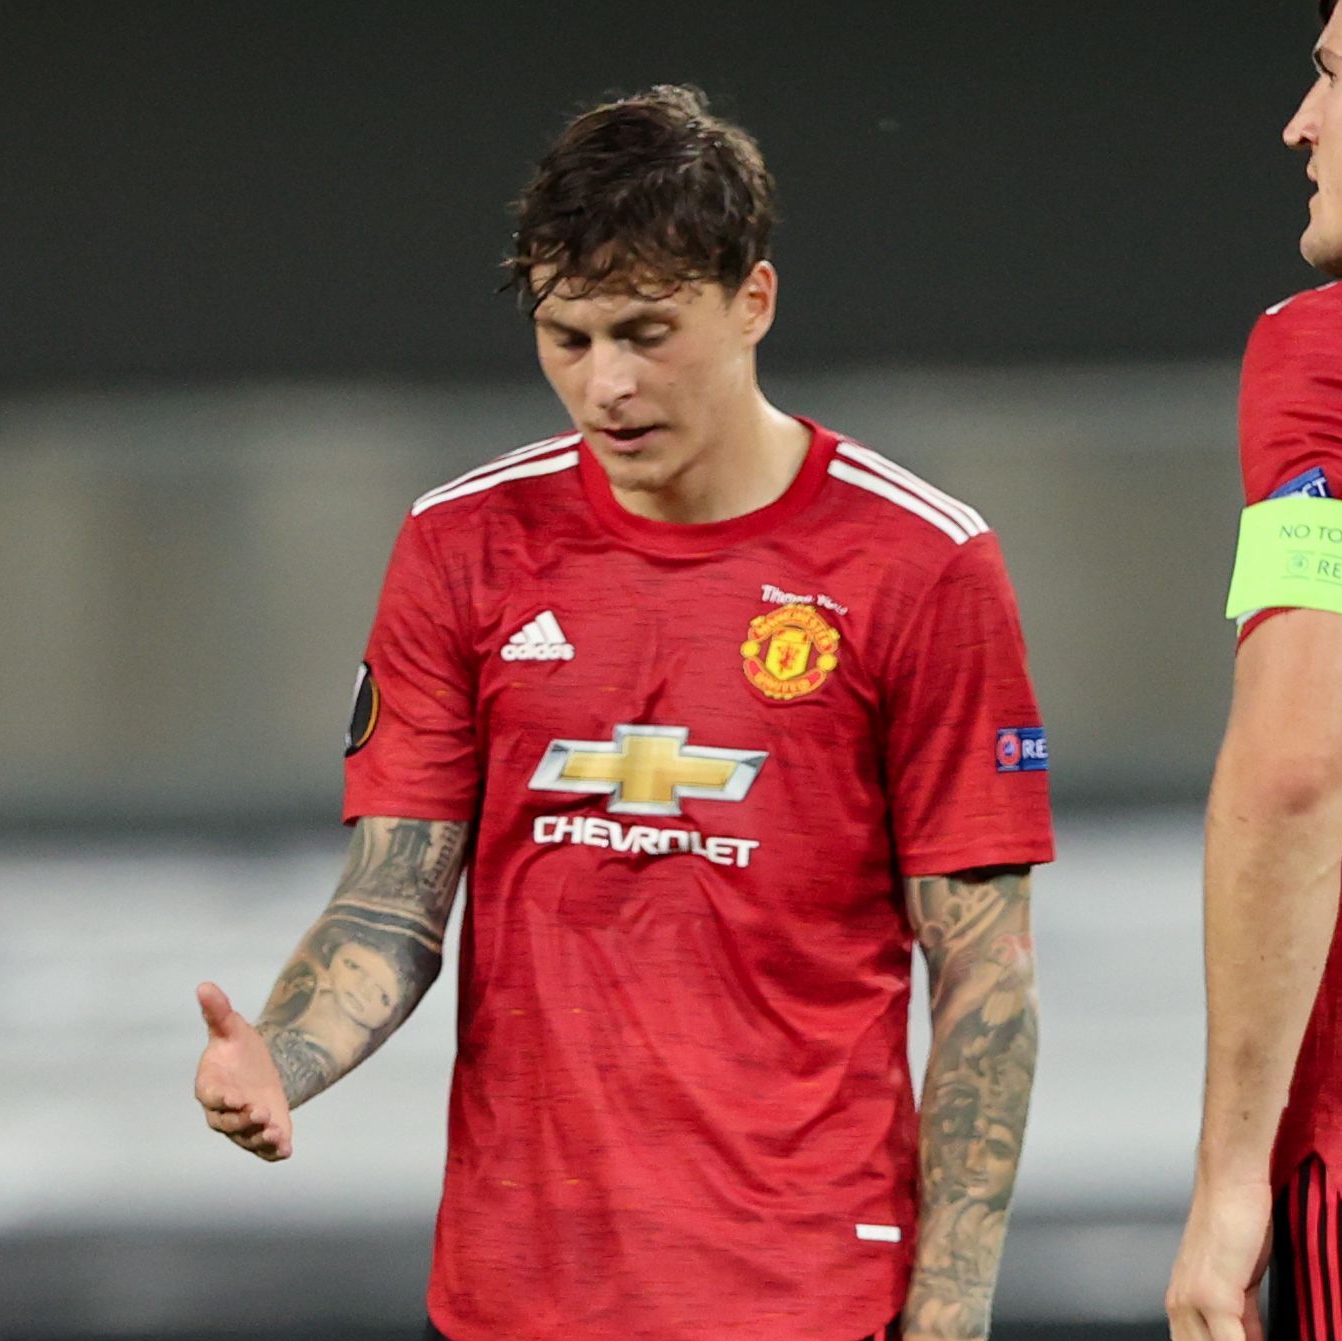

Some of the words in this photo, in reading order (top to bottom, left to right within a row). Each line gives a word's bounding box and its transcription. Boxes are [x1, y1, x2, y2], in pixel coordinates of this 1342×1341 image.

[1279, 524, 1311, 540] NO
[500, 643, 576, 662] adidas
[533, 816, 760, 869] CHEVROLET
